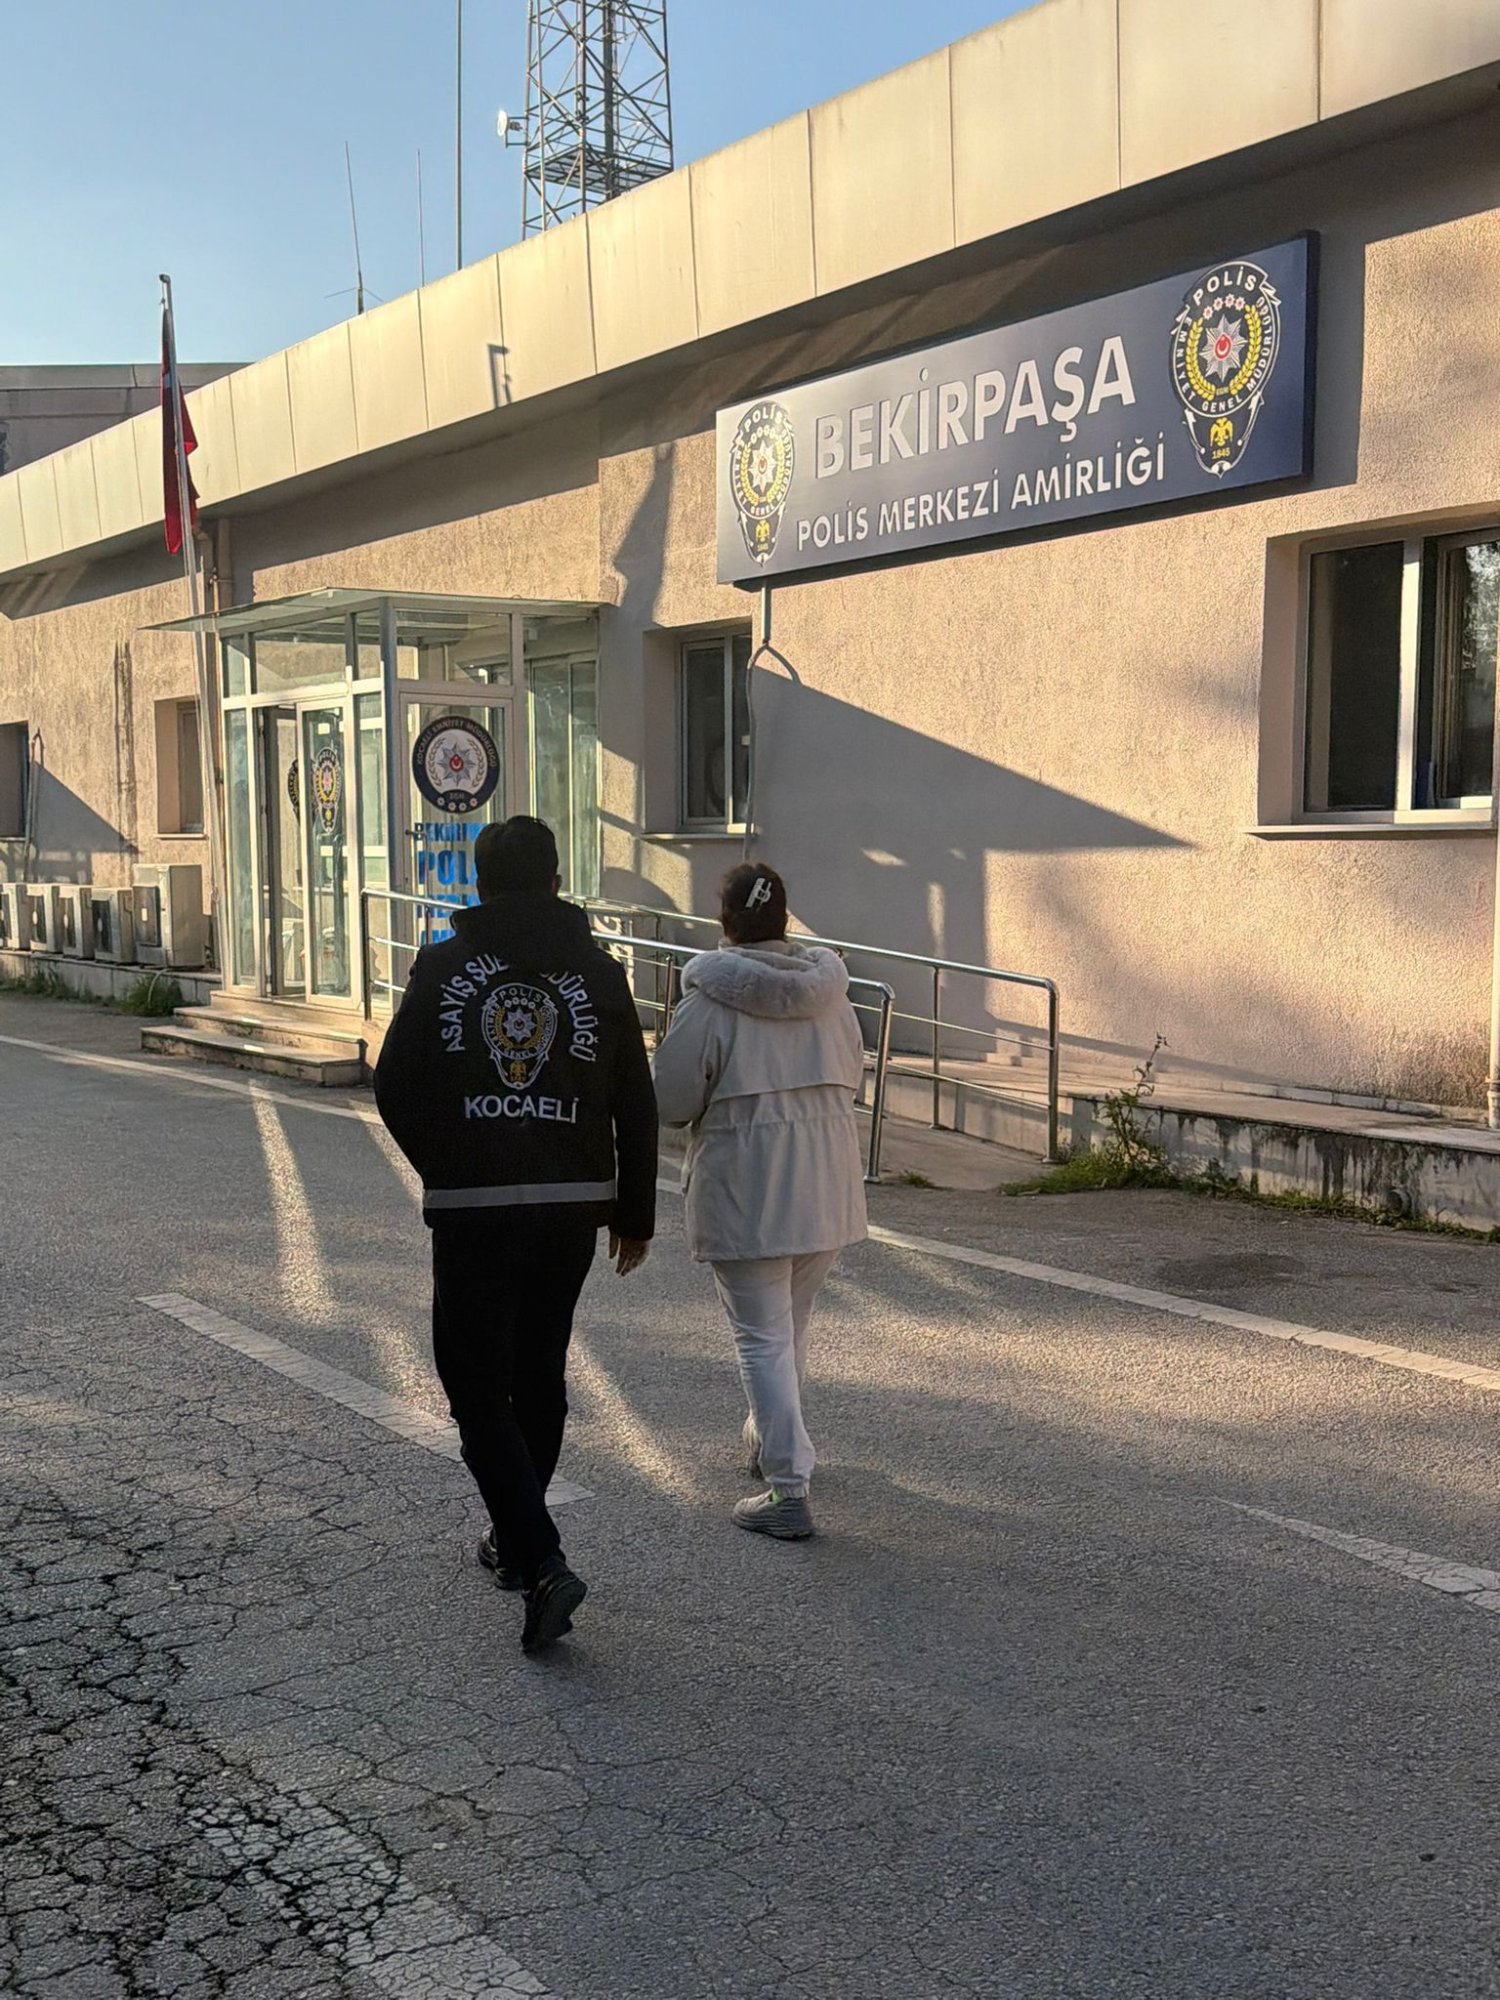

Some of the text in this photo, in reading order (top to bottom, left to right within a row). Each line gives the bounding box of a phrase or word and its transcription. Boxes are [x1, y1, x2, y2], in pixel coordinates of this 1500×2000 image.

[1193, 265, 1257, 307] POLİS
[815, 336, 1136, 479] BEKİRPAŞA
[1202, 394, 1243, 413] GENEL
[797, 431, 1165, 551] POLİS MERKEZİ AMİRLİĞİ
[438, 974, 478, 1053] ASAYİŞ
[499, 985, 543, 1003] POLİS
[464, 1095, 579, 1124] KOCAELİ
